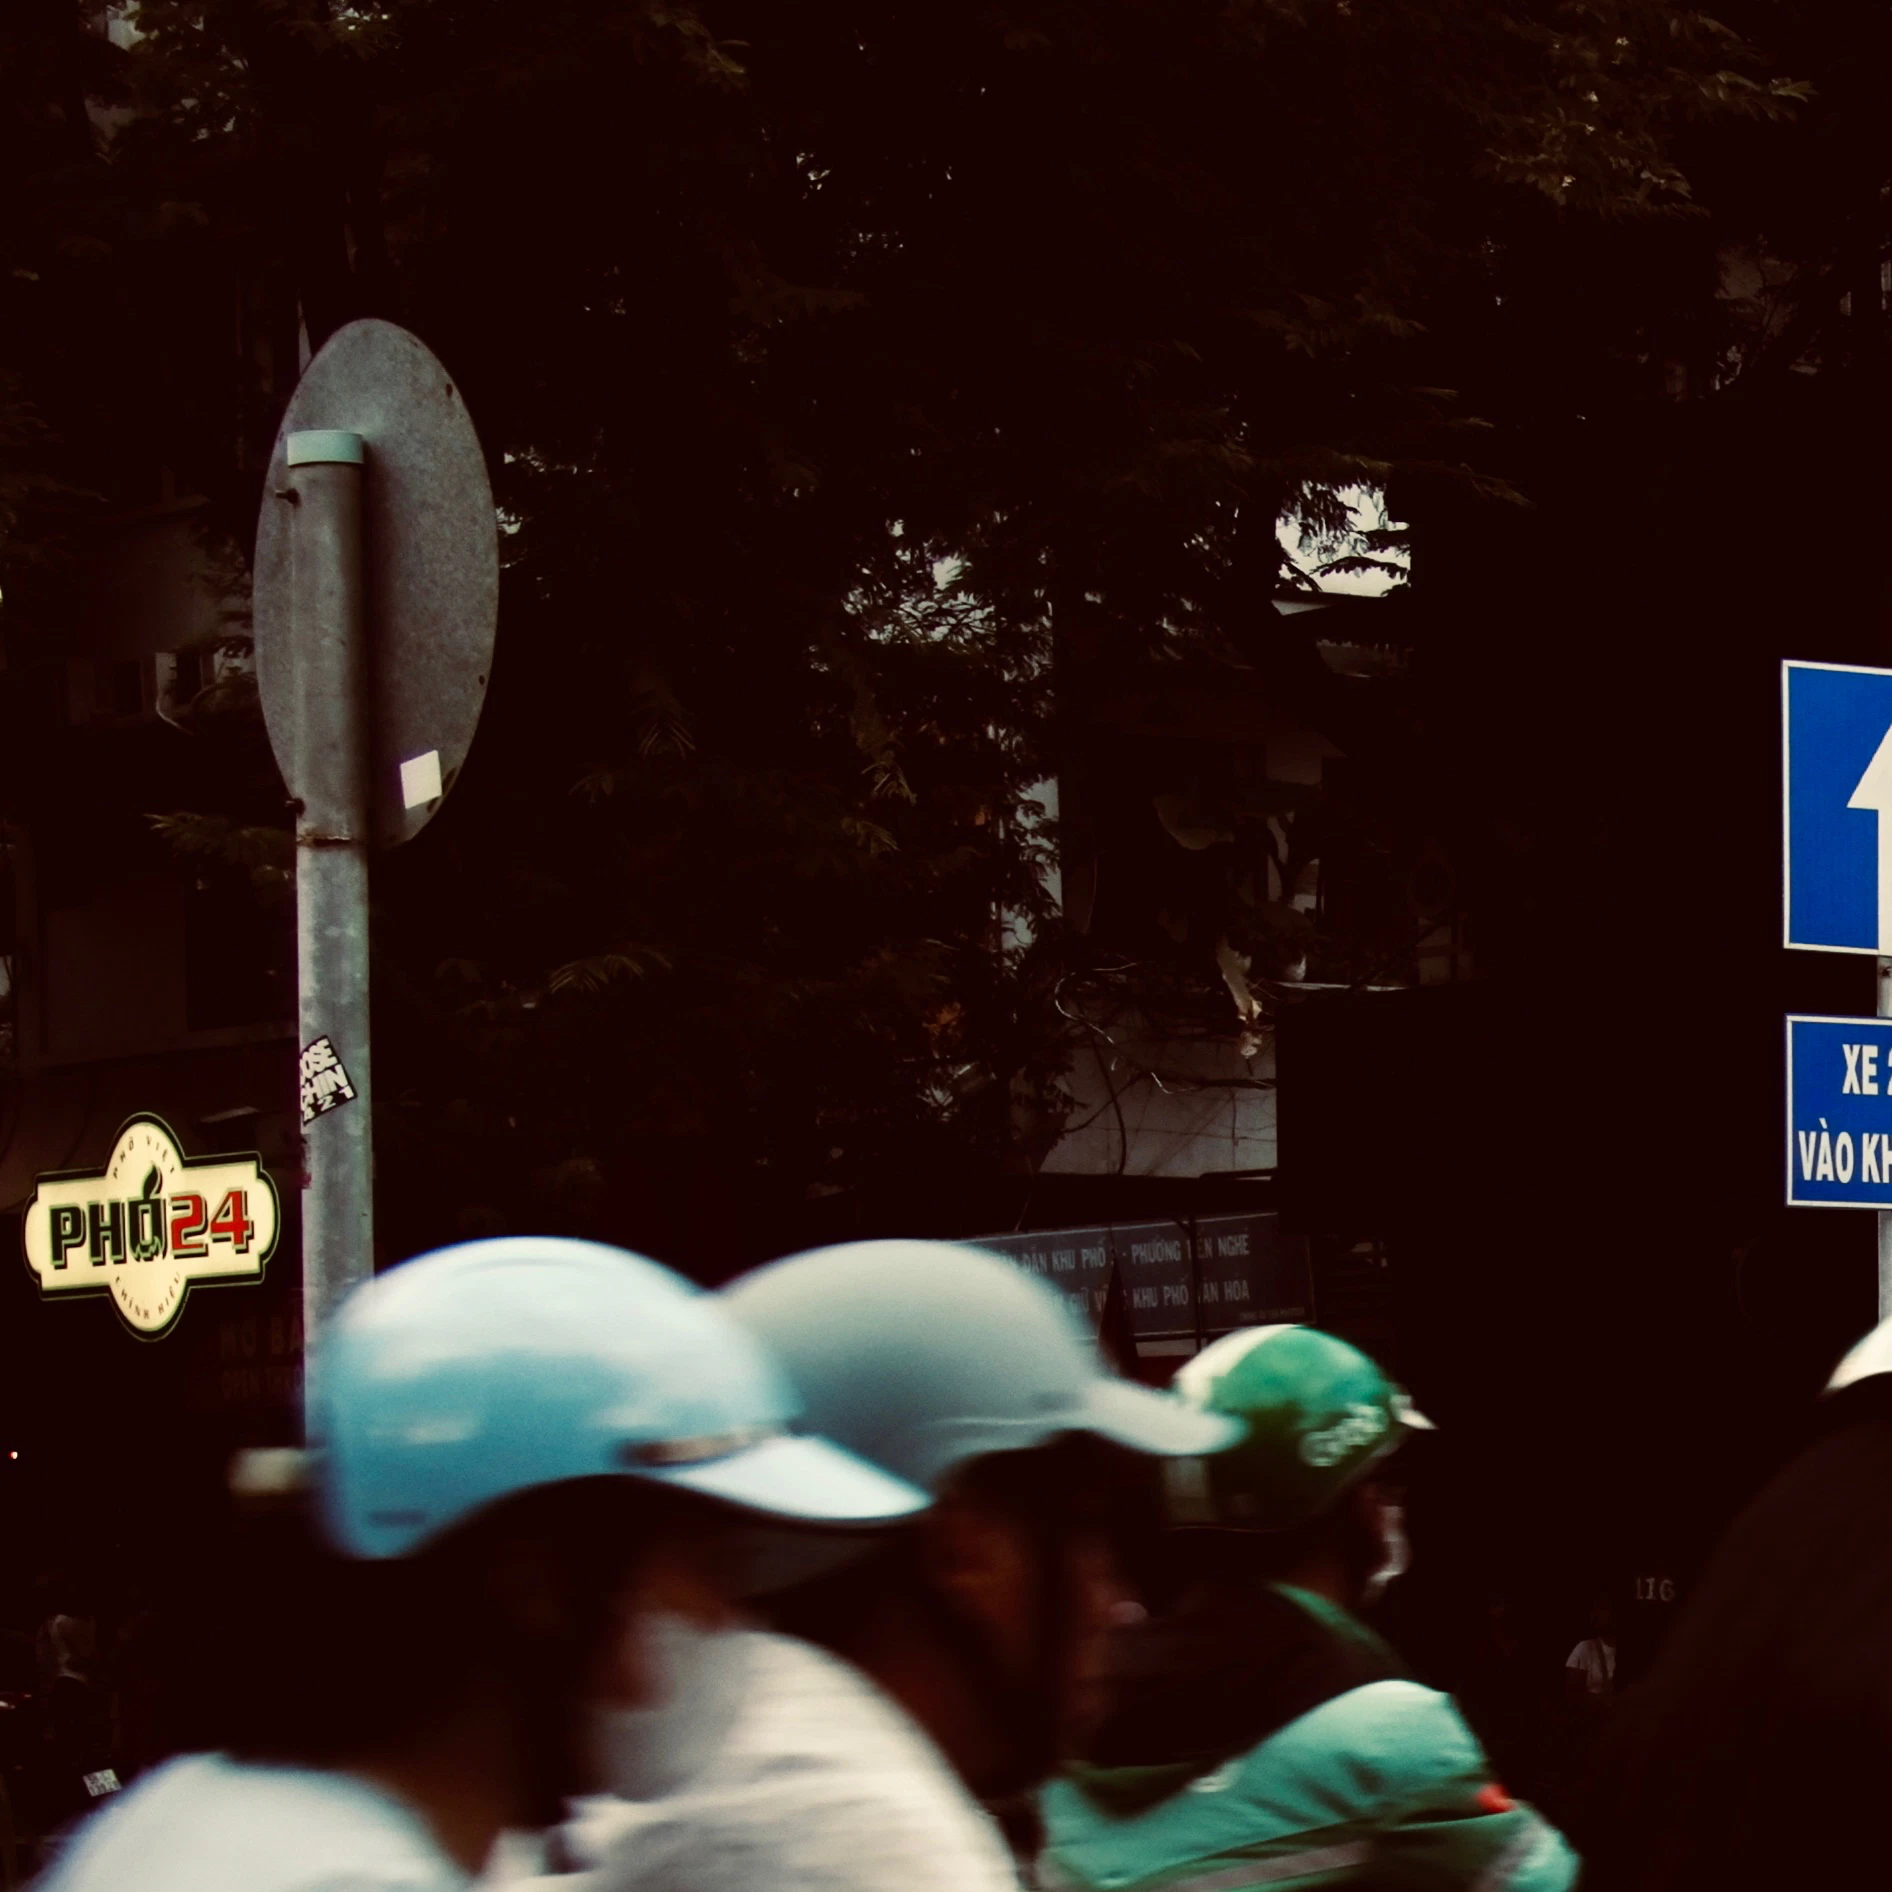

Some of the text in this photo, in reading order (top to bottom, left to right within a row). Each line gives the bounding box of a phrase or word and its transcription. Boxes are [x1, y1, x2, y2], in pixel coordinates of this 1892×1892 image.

[1842, 1044, 1879, 1095] XE
[1799, 1118, 1854, 1184] VÀO
[1051, 1249, 1076, 1272] KHU
[1132, 1286, 1158, 1309] KHU
